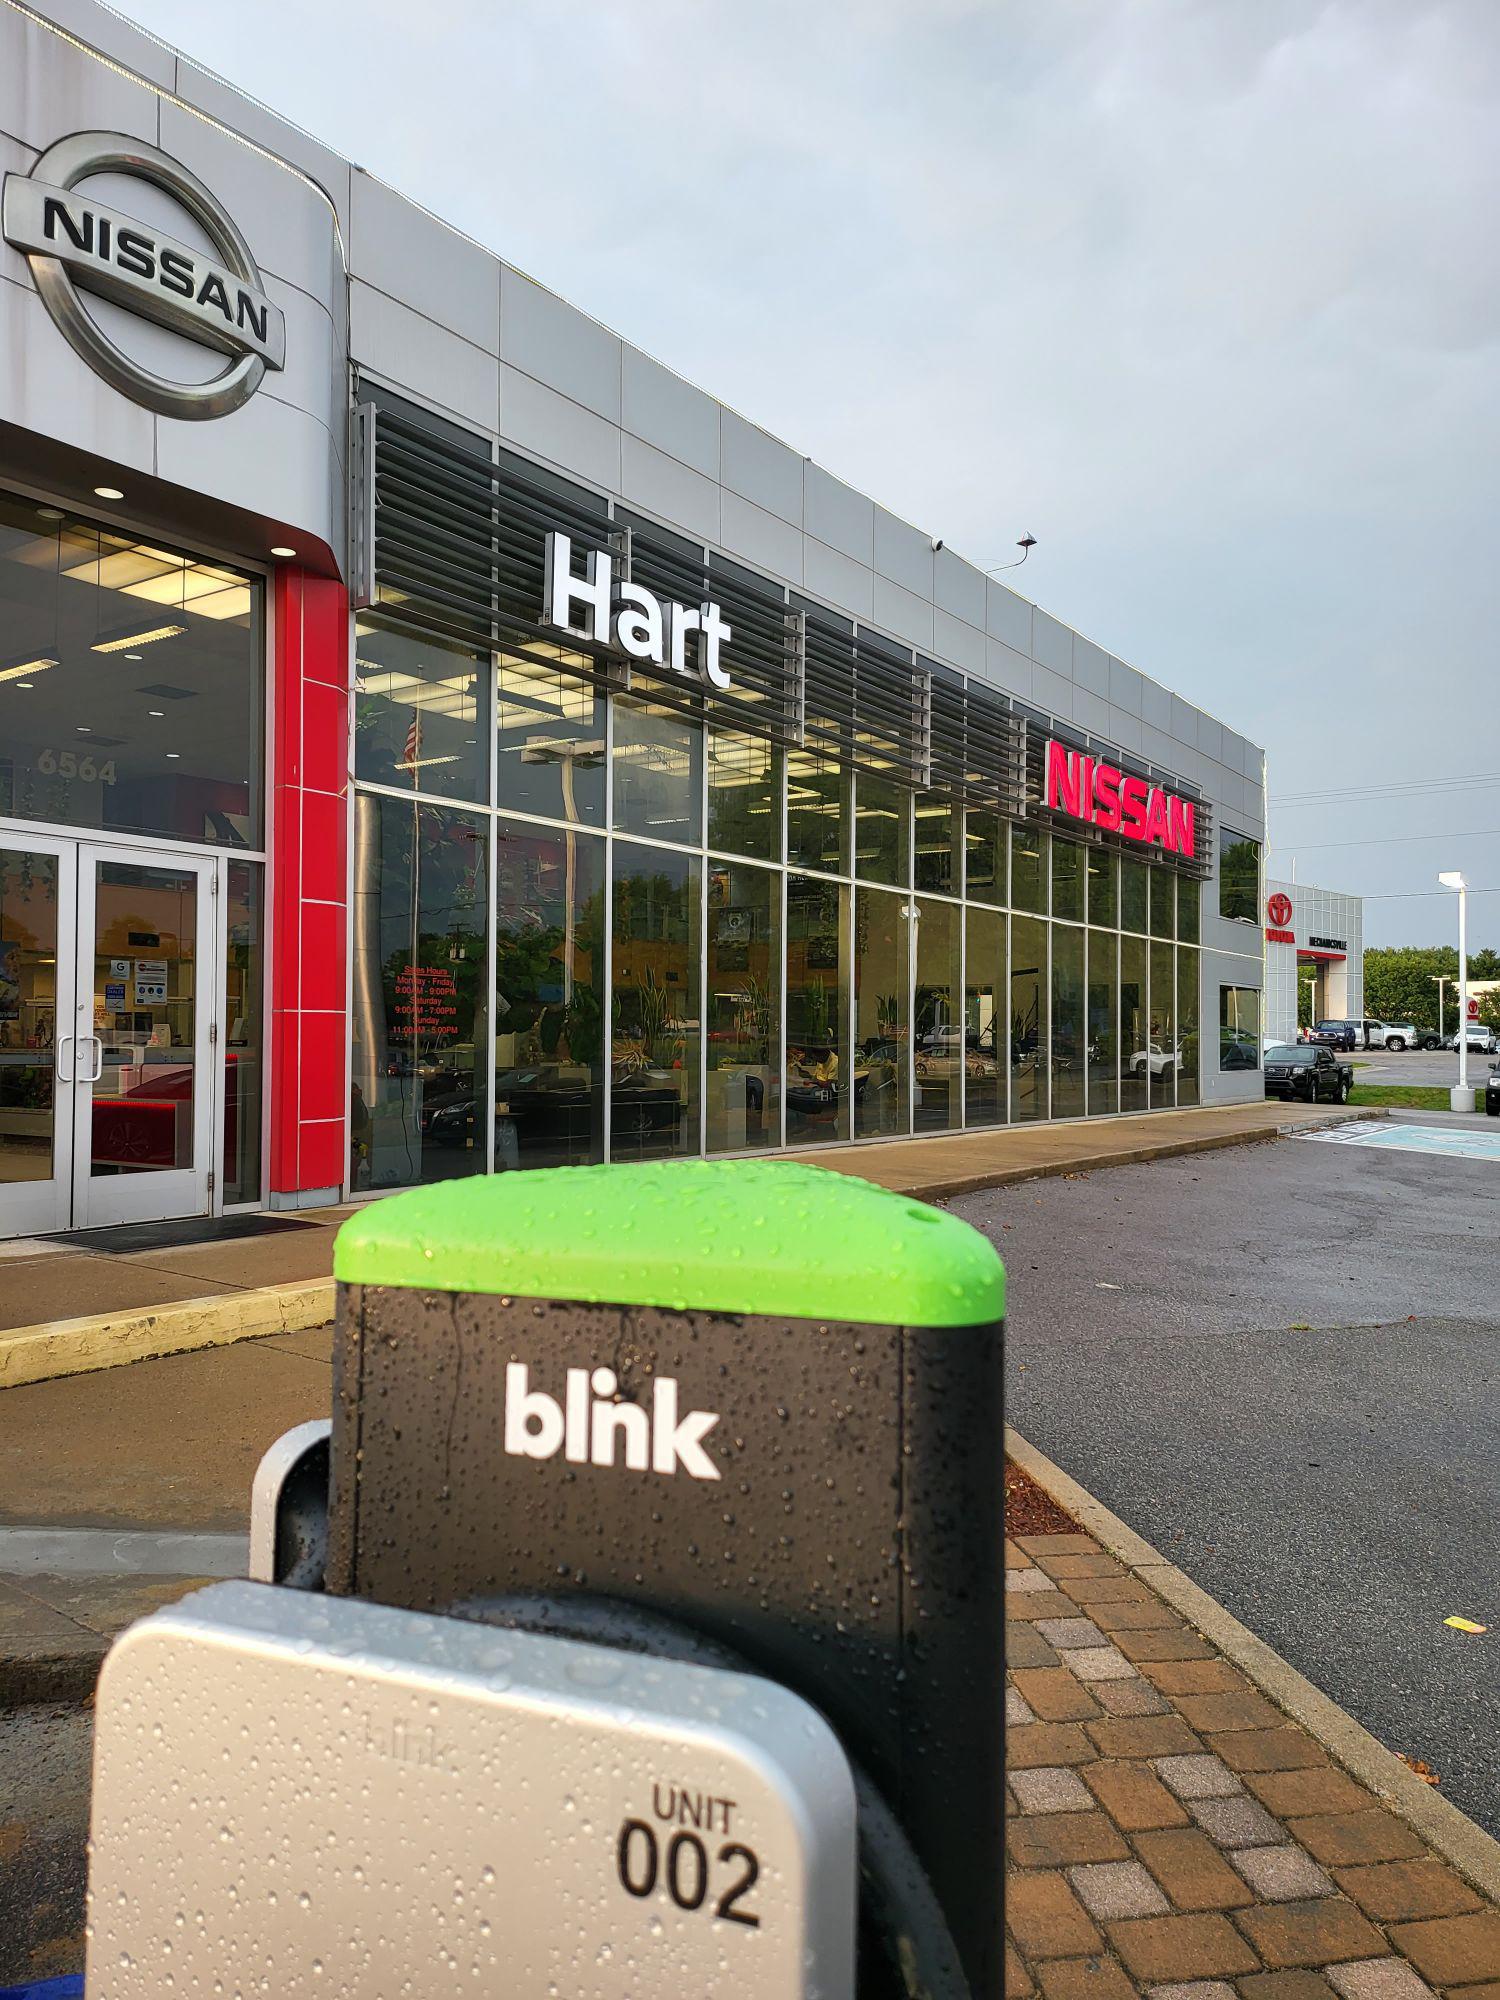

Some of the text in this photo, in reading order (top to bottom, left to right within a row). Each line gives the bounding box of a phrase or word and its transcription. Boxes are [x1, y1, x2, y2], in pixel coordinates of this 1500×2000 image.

[44, 197, 269, 343] NISSAN
[544, 531, 731, 688] Hart
[38, 749, 117, 786] 6564
[1045, 740, 1194, 857] NISSAN
[426, 966, 448, 975] Hours
[429, 987, 456, 996] 9:00PM
[432, 977, 453, 988] Friday
[429, 1006, 457, 1015] 7:00PM
[431, 1026, 458, 1034] 5:00PM
[504, 1363, 722, 1481] blink
[652, 1783, 739, 1836] UNIT
[617, 1818, 761, 1927] 002
